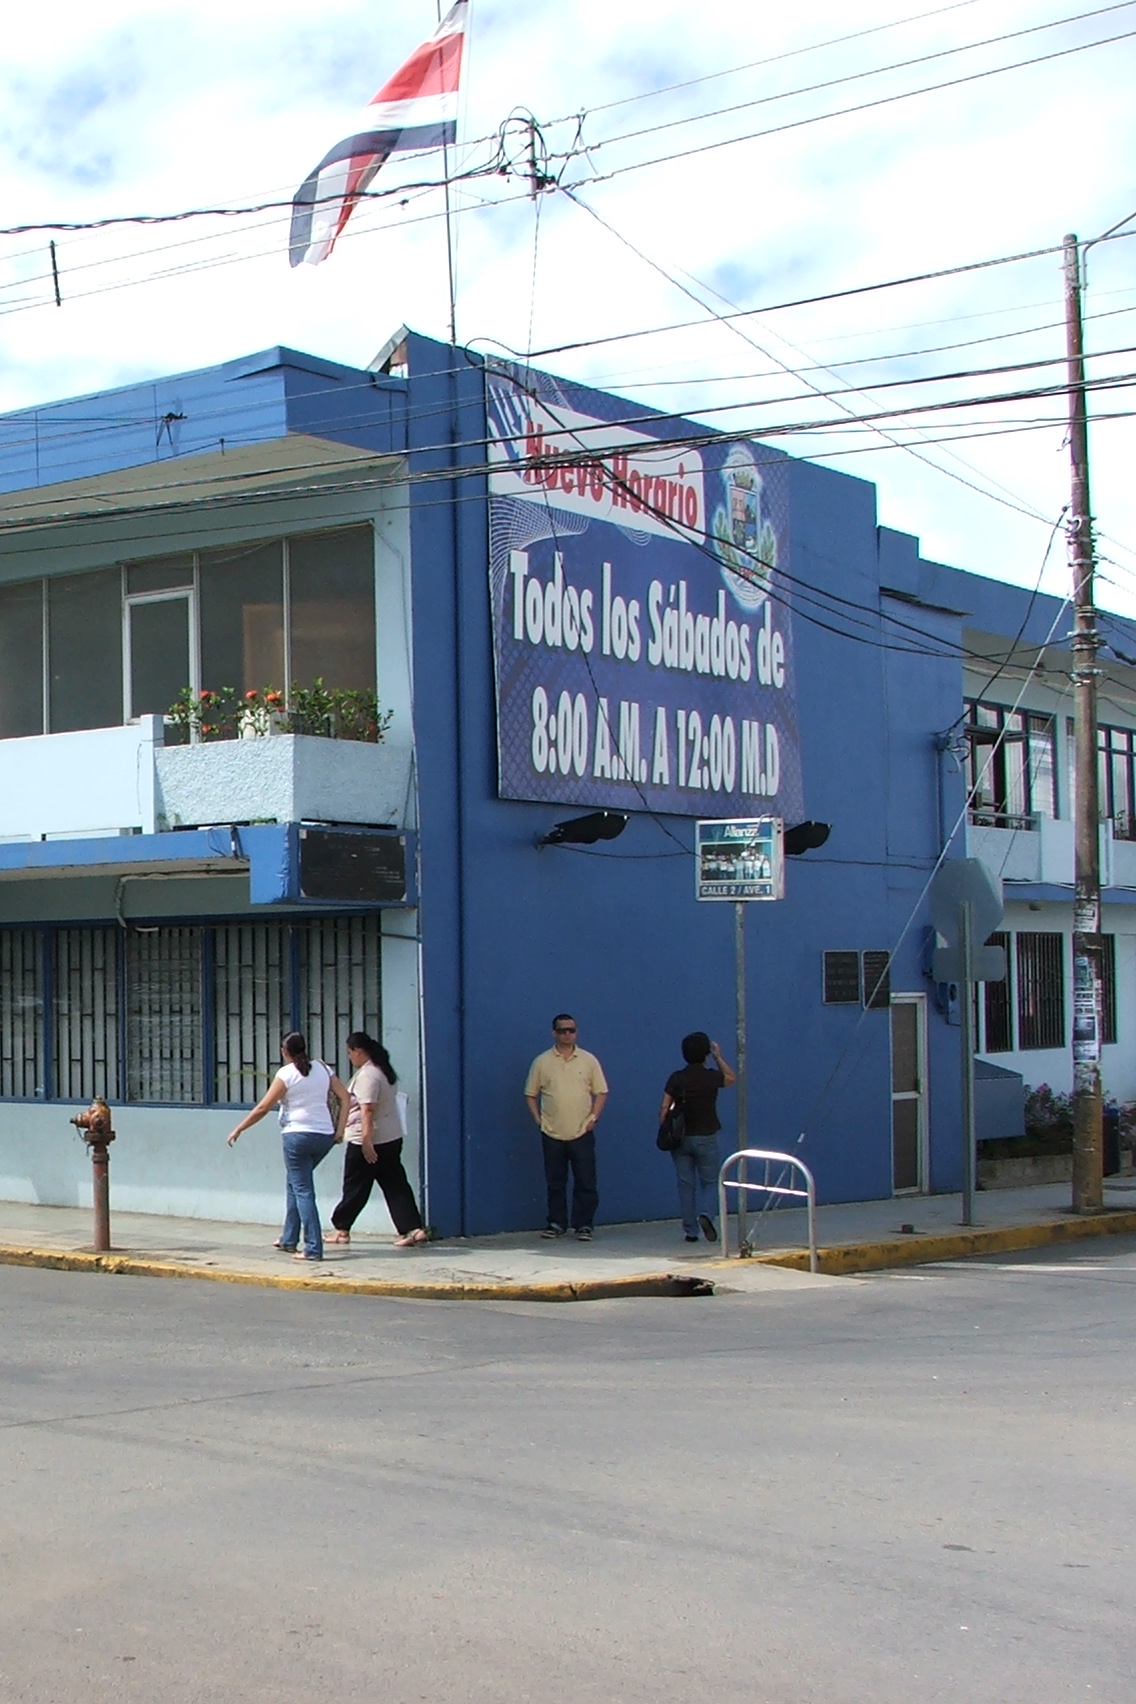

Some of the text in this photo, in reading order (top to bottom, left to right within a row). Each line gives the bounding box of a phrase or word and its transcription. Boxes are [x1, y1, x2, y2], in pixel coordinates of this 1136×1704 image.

[523, 421, 698, 529] Nuevo Horario
[509, 550, 786, 689] Todos los Sábados de
[532, 685, 587, 777] 8:00
[594, 697, 647, 784] A.M.
[652, 706, 670, 786] A
[677, 708, 735, 795] 12:00
[701, 886, 728, 895] CALLE
[730, 886, 736, 895] 2
[743, 885, 764, 895] AVE.
